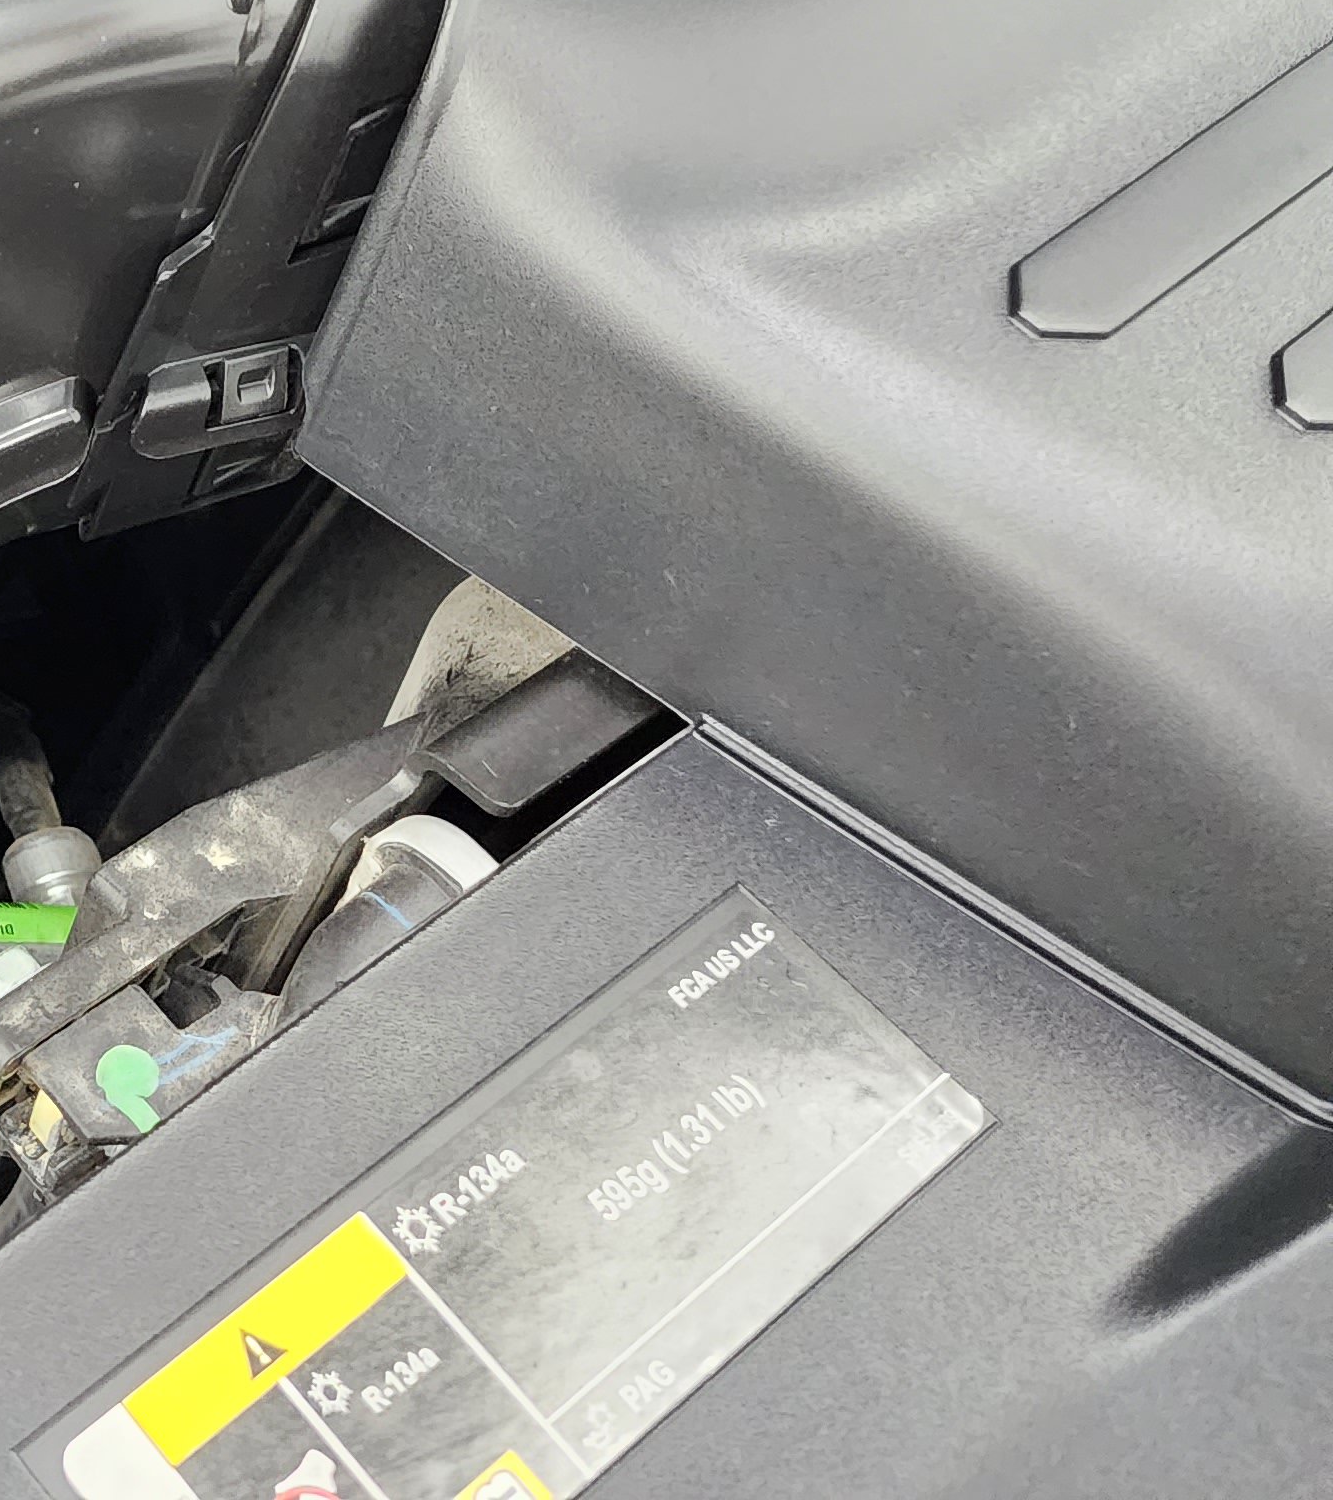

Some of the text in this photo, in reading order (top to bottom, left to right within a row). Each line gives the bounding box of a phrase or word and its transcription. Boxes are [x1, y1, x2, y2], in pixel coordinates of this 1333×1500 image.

[667, 922, 775, 1009] FCA US LLC
[587, 1074, 766, 1221] 595g (1.31 lb)
[430, 1149, 527, 1225] R-134a
[361, 1347, 441, 1414] R-134a
[618, 1359, 677, 1413] PAG
